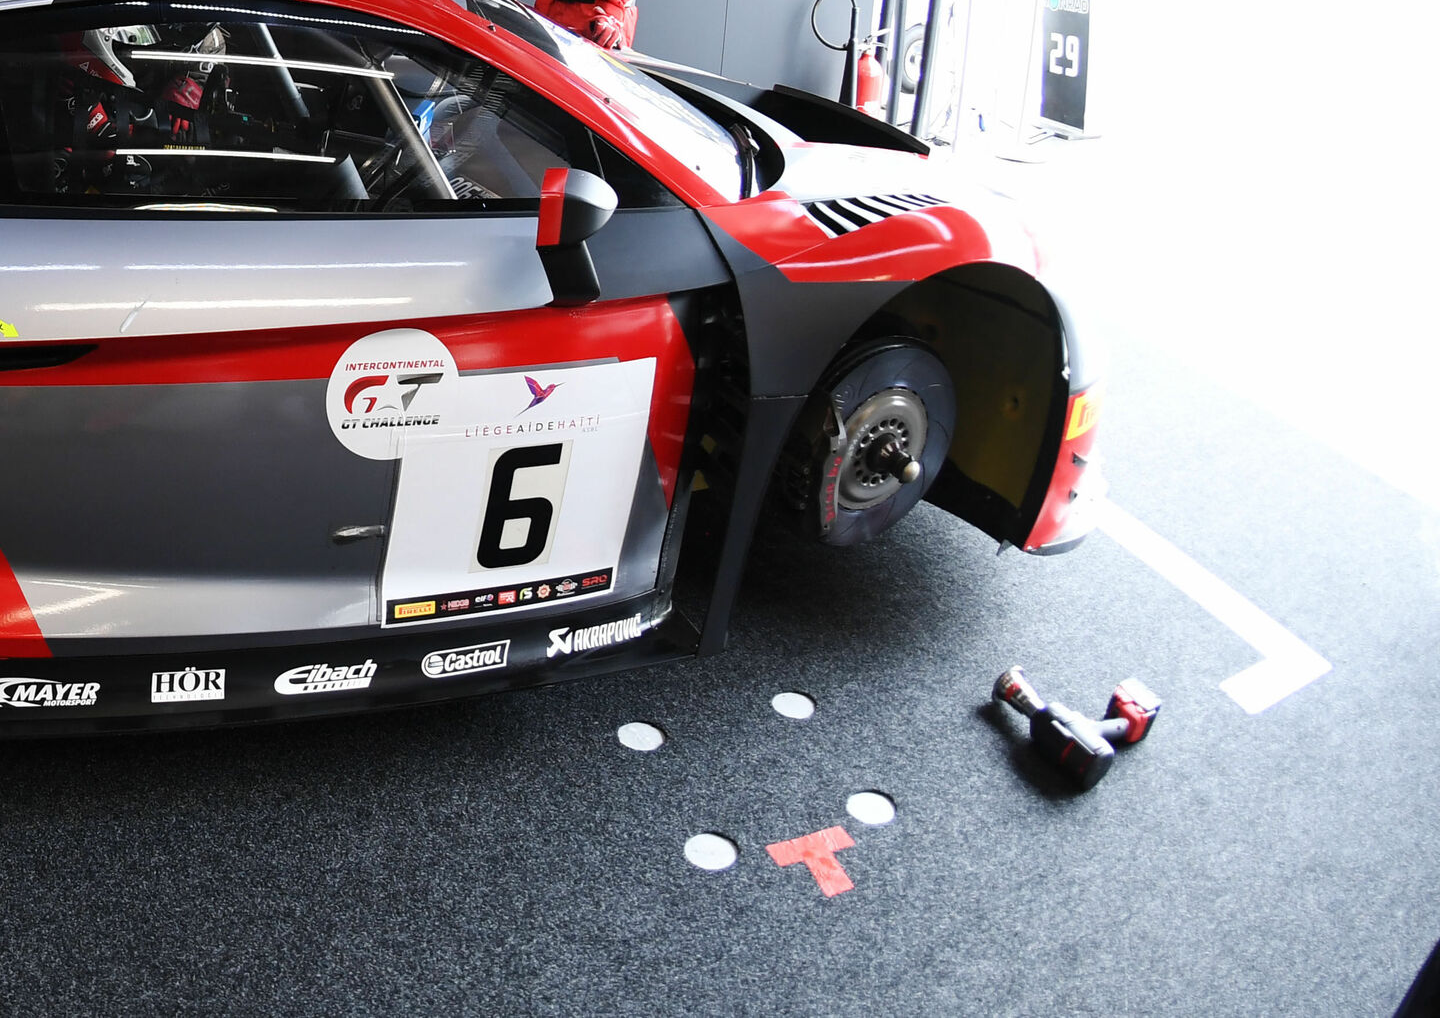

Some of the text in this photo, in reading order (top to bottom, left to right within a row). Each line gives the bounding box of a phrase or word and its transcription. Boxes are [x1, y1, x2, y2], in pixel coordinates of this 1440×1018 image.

[1049, 32, 1080, 78] 29
[345, 359, 445, 371] INTERCONTINENTAL
[341, 415, 441, 430] GT CHALLENGE
[476, 442, 563, 570] 6
[444, 645, 502, 672] Castrol
[153, 666, 223, 694] HÖR
[274, 659, 378, 694] Eibach
[11, 681, 101, 702] MAYER
[42, 698, 96, 707] MOTORSPORT
